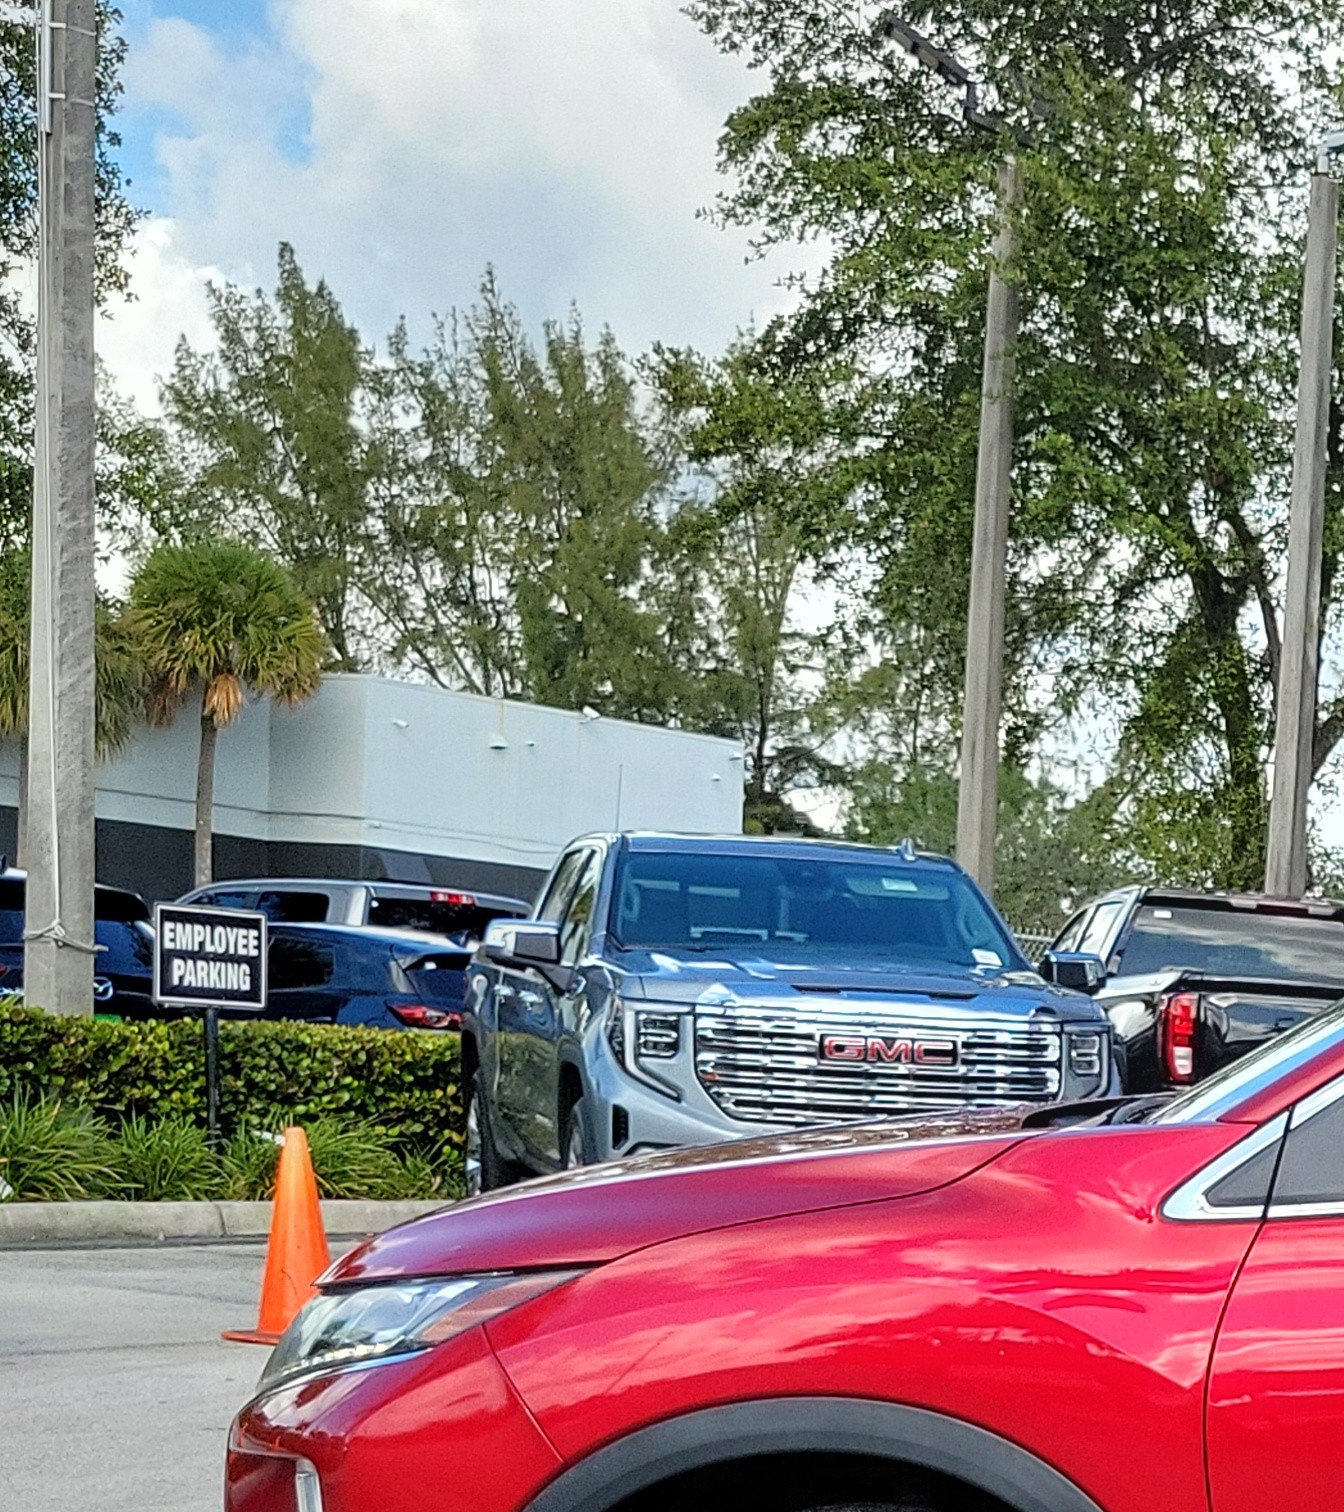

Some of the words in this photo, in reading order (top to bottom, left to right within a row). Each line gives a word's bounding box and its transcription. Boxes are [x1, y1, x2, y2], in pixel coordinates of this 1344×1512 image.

[163, 921, 259, 957] EMPLOYEE
[173, 958, 251, 991] PARKING
[824, 1036, 954, 1064] GMC
